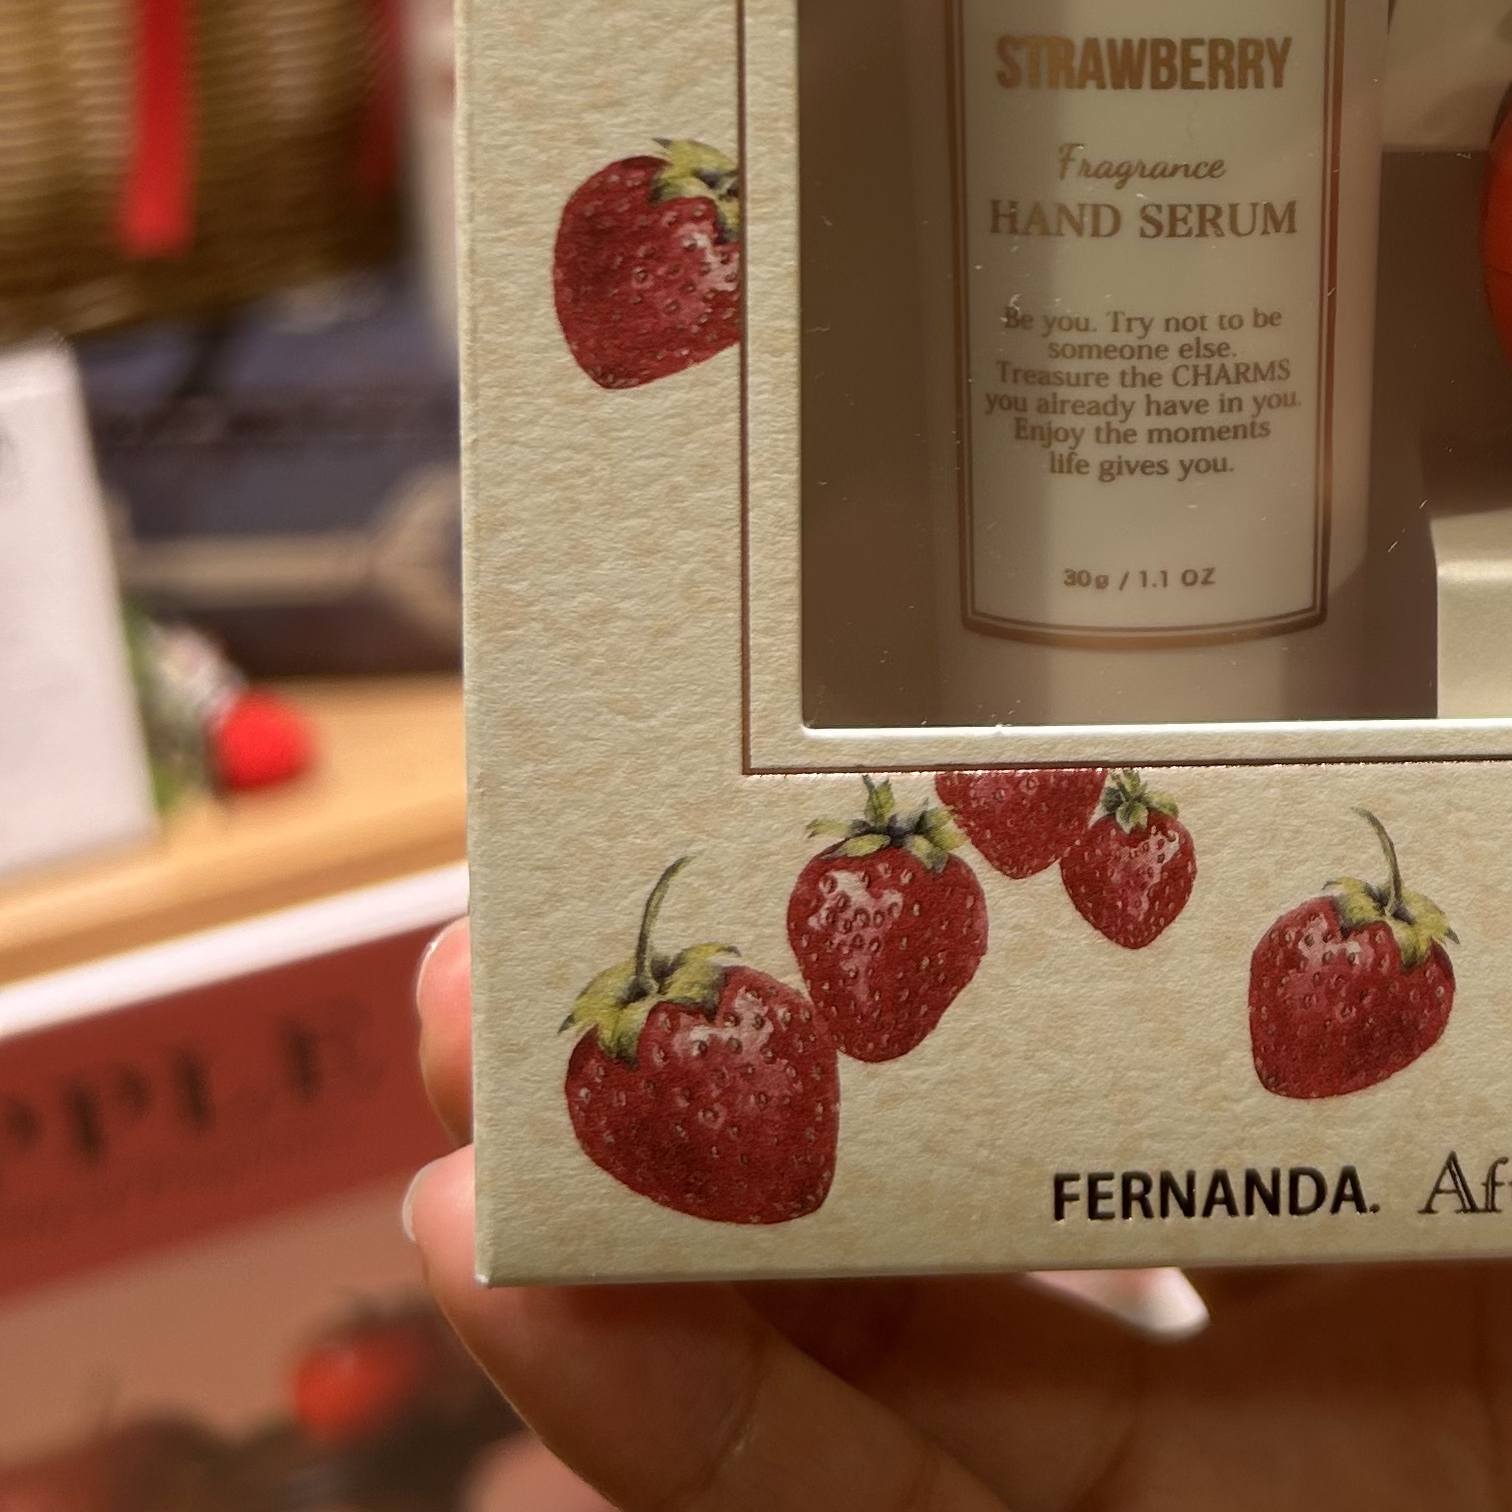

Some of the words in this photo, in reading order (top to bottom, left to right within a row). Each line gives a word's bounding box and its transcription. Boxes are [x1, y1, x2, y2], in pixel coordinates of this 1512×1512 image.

[995, 36, 1293, 91] STRAWBERRY
[1057, 143, 1227, 189] Fragrance
[989, 199, 1123, 238] HAND
[1138, 199, 1298, 240] SERUM
[1002, 306, 1034, 330] Be
[1041, 311, 1097, 337] you.
[1105, 309, 1154, 340] Try
[1164, 311, 1208, 333] not
[1218, 308, 1244, 330] to
[1252, 306, 1283, 328] be
[1048, 341, 1169, 361] someone
[1178, 336, 1237, 360] else.
[996, 360, 1109, 387] Treasure
[1119, 366, 1163, 388] the
[1172, 358, 1291, 387] CHARMS
[984, 391, 1027, 415] you
[1036, 392, 1136, 423] already
[1145, 392, 1209, 417] have
[1218, 392, 1244, 415] in
[1252, 388, 1302, 418] you.
[1014, 417, 1085, 450] Enjoy
[1095, 421, 1138, 444] the
[1148, 418, 1271, 444] moments
[1050, 451, 1090, 475] life
[1098, 454, 1168, 483] gives
[1177, 453, 1234, 482] you.
[1063, 568, 1109, 589] 30g
[1119, 571, 1130, 591] /
[1139, 569, 1168, 588] 1.1
[1181, 567, 1216, 587] OZ
[1052, 1165, 1380, 1222] FERNANDA.
